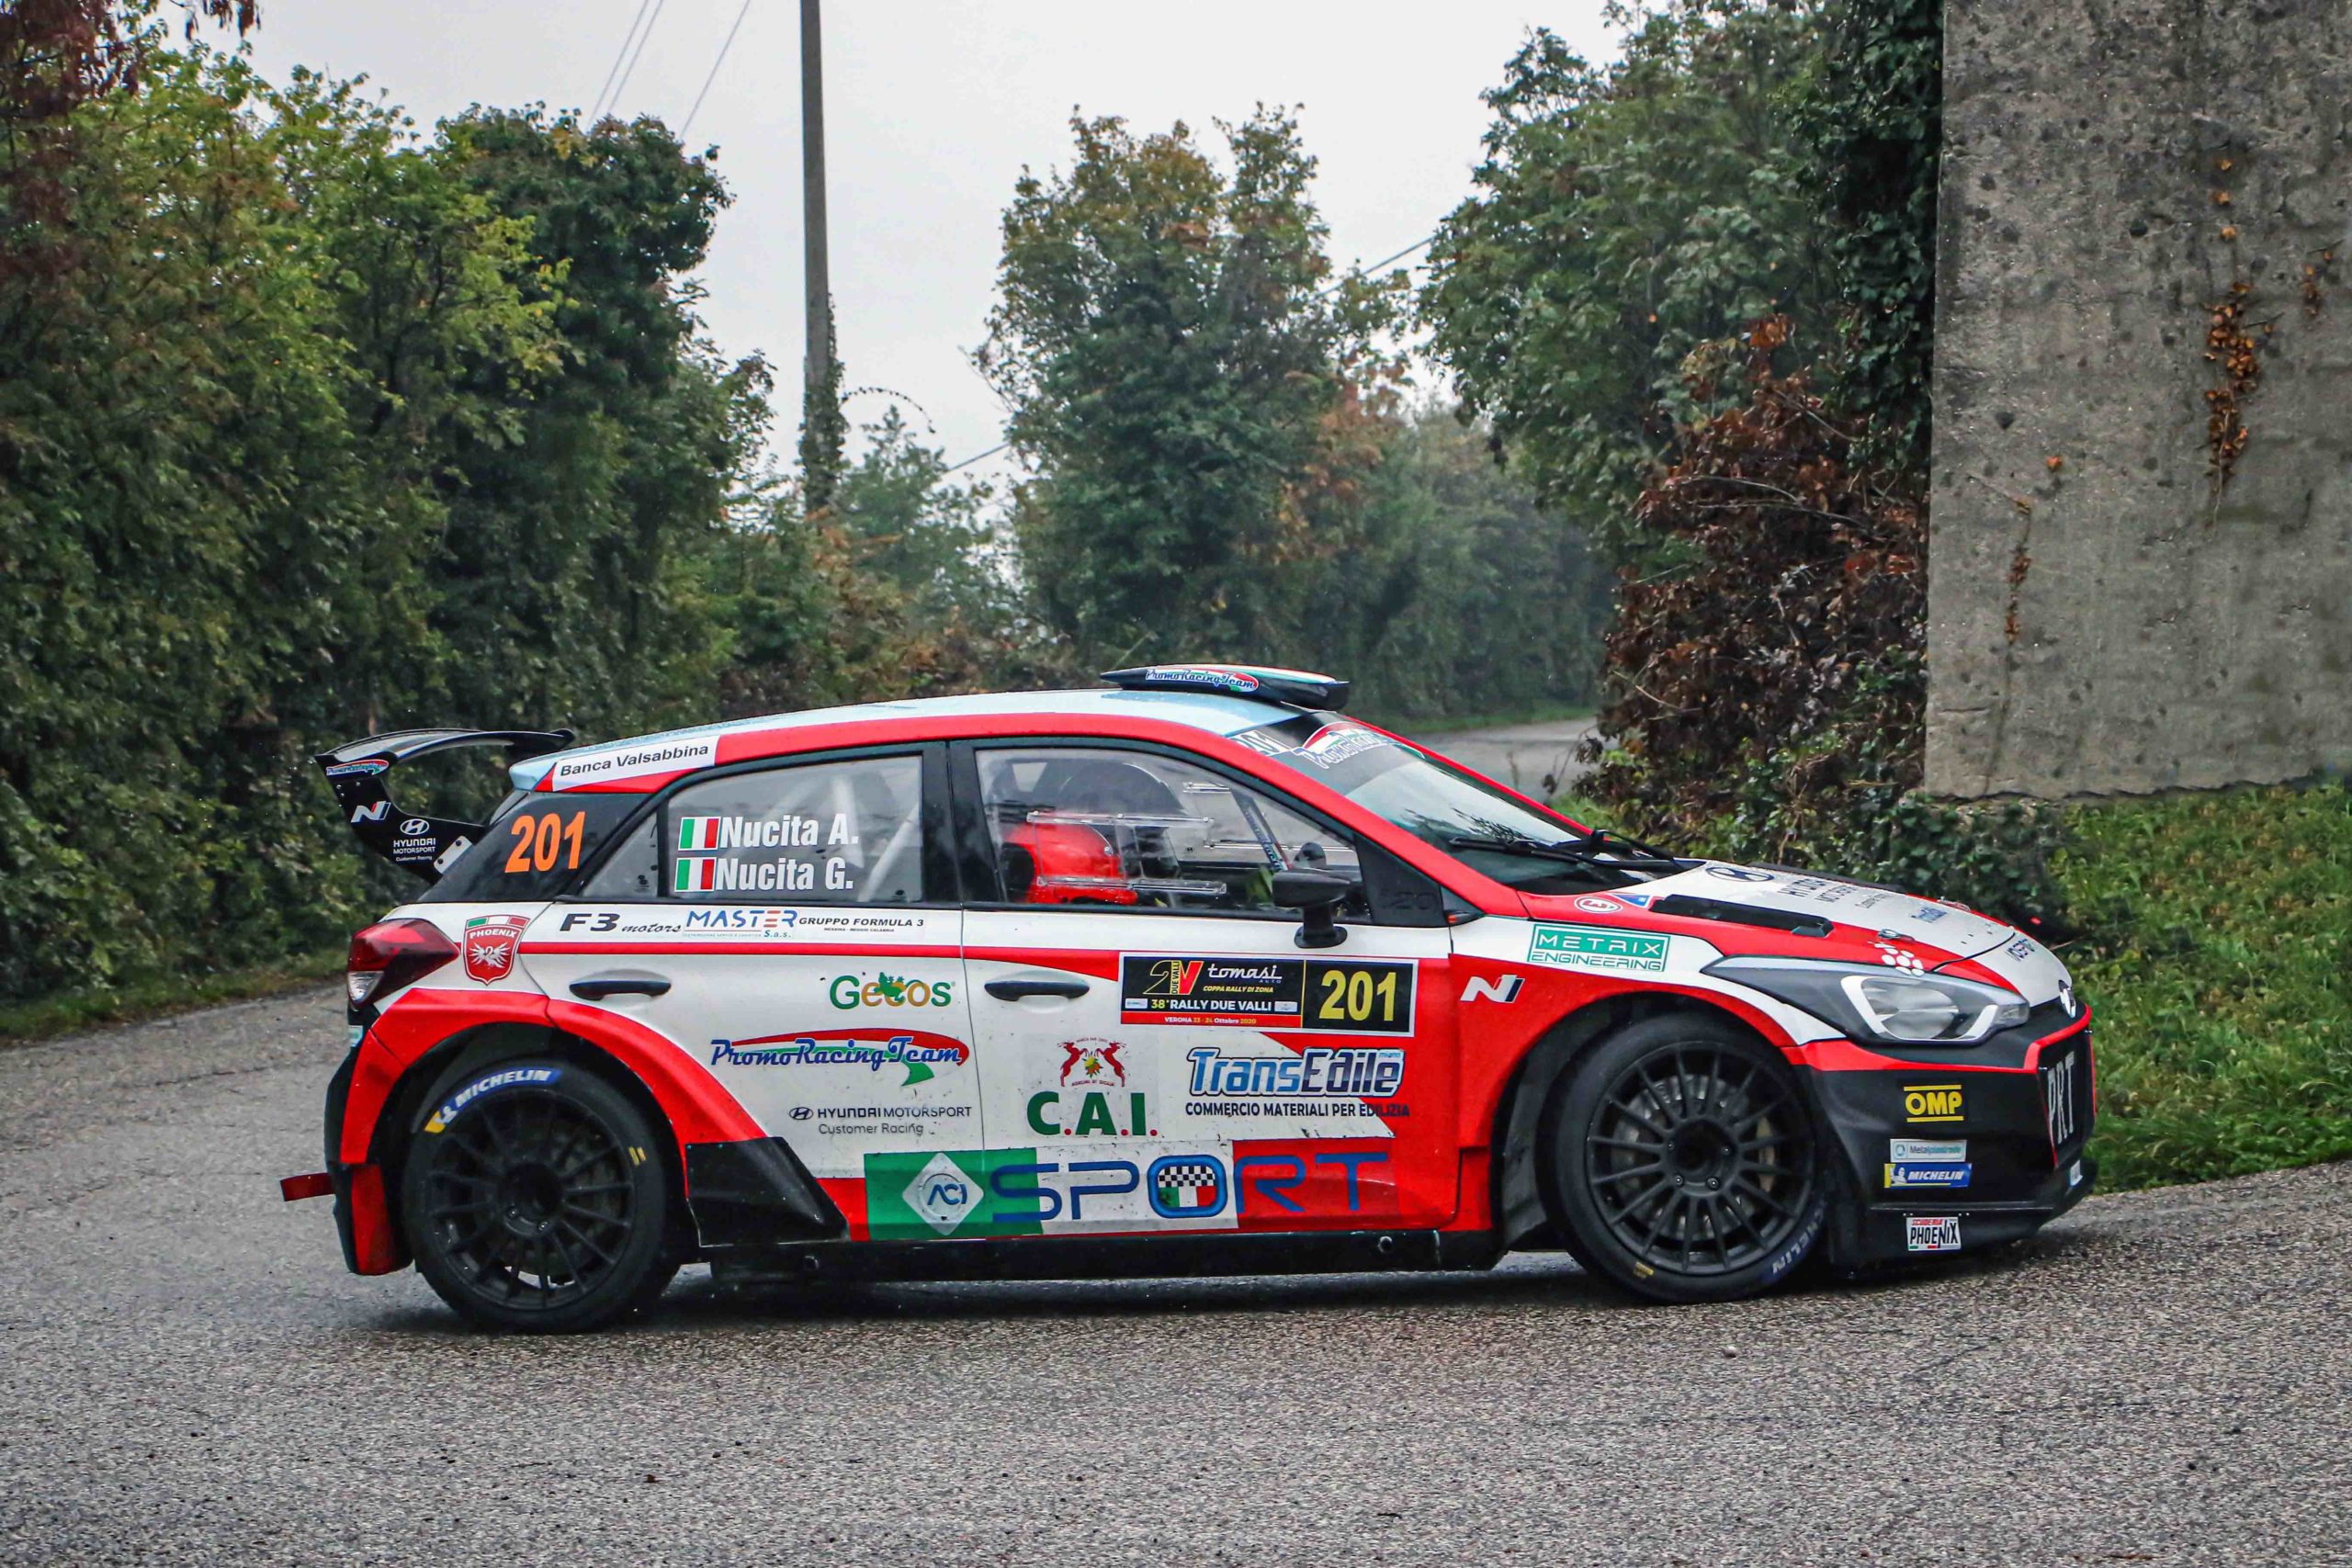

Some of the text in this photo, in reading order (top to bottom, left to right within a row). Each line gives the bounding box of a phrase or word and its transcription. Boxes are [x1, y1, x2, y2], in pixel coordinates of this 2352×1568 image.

[560, 746, 708, 776] Banca Valsabbina
[504, 811, 585, 873] 201
[720, 813, 859, 848] Nucita A.
[393, 838, 436, 848] HYUNDAI
[393, 846, 436, 854] MOTORSPORT
[716, 856, 854, 892] Nucita G.
[560, 913, 682, 933] F3 motors
[798, 917, 924, 927] GRUPPO FORMULA 3
[469, 929, 518, 940] PHOENIX
[1538, 933, 1662, 956] METRIX
[1207, 964, 1283, 980] tomasi
[1531, 951, 1662, 971] ENGINEERING
[1170, 999, 1209, 1010] RALLY
[1210, 1000, 1236, 1010] DUE
[1238, 1000, 1272, 1011] VALLI
[1318, 970, 1397, 1021] 201
[710, 1036, 962, 1071] PromoRacingTeam
[1188, 1048, 1404, 1096] TransEdile
[454, 1069, 551, 1108] MICHELIN
[2047, 1051, 2075, 1145] PRT
[818, 1106, 972, 1118] HYUNDAI MOTORSPORT
[1026, 1090, 1158, 1136] C.A.I.
[1185, 1102, 1410, 1118] COMMERCIO MATERIALI PER EDILIZIA
[1905, 1091, 1962, 1115] OMP
[818, 1122, 924, 1137] Customer Racing
[1907, 1170, 1964, 1180] MICHELIN
[927, 1152, 1389, 1224] ACI SPORT
[1771, 1200, 1826, 1275] CHELIN
[1909, 1220, 1959, 1248] PHOENIX
